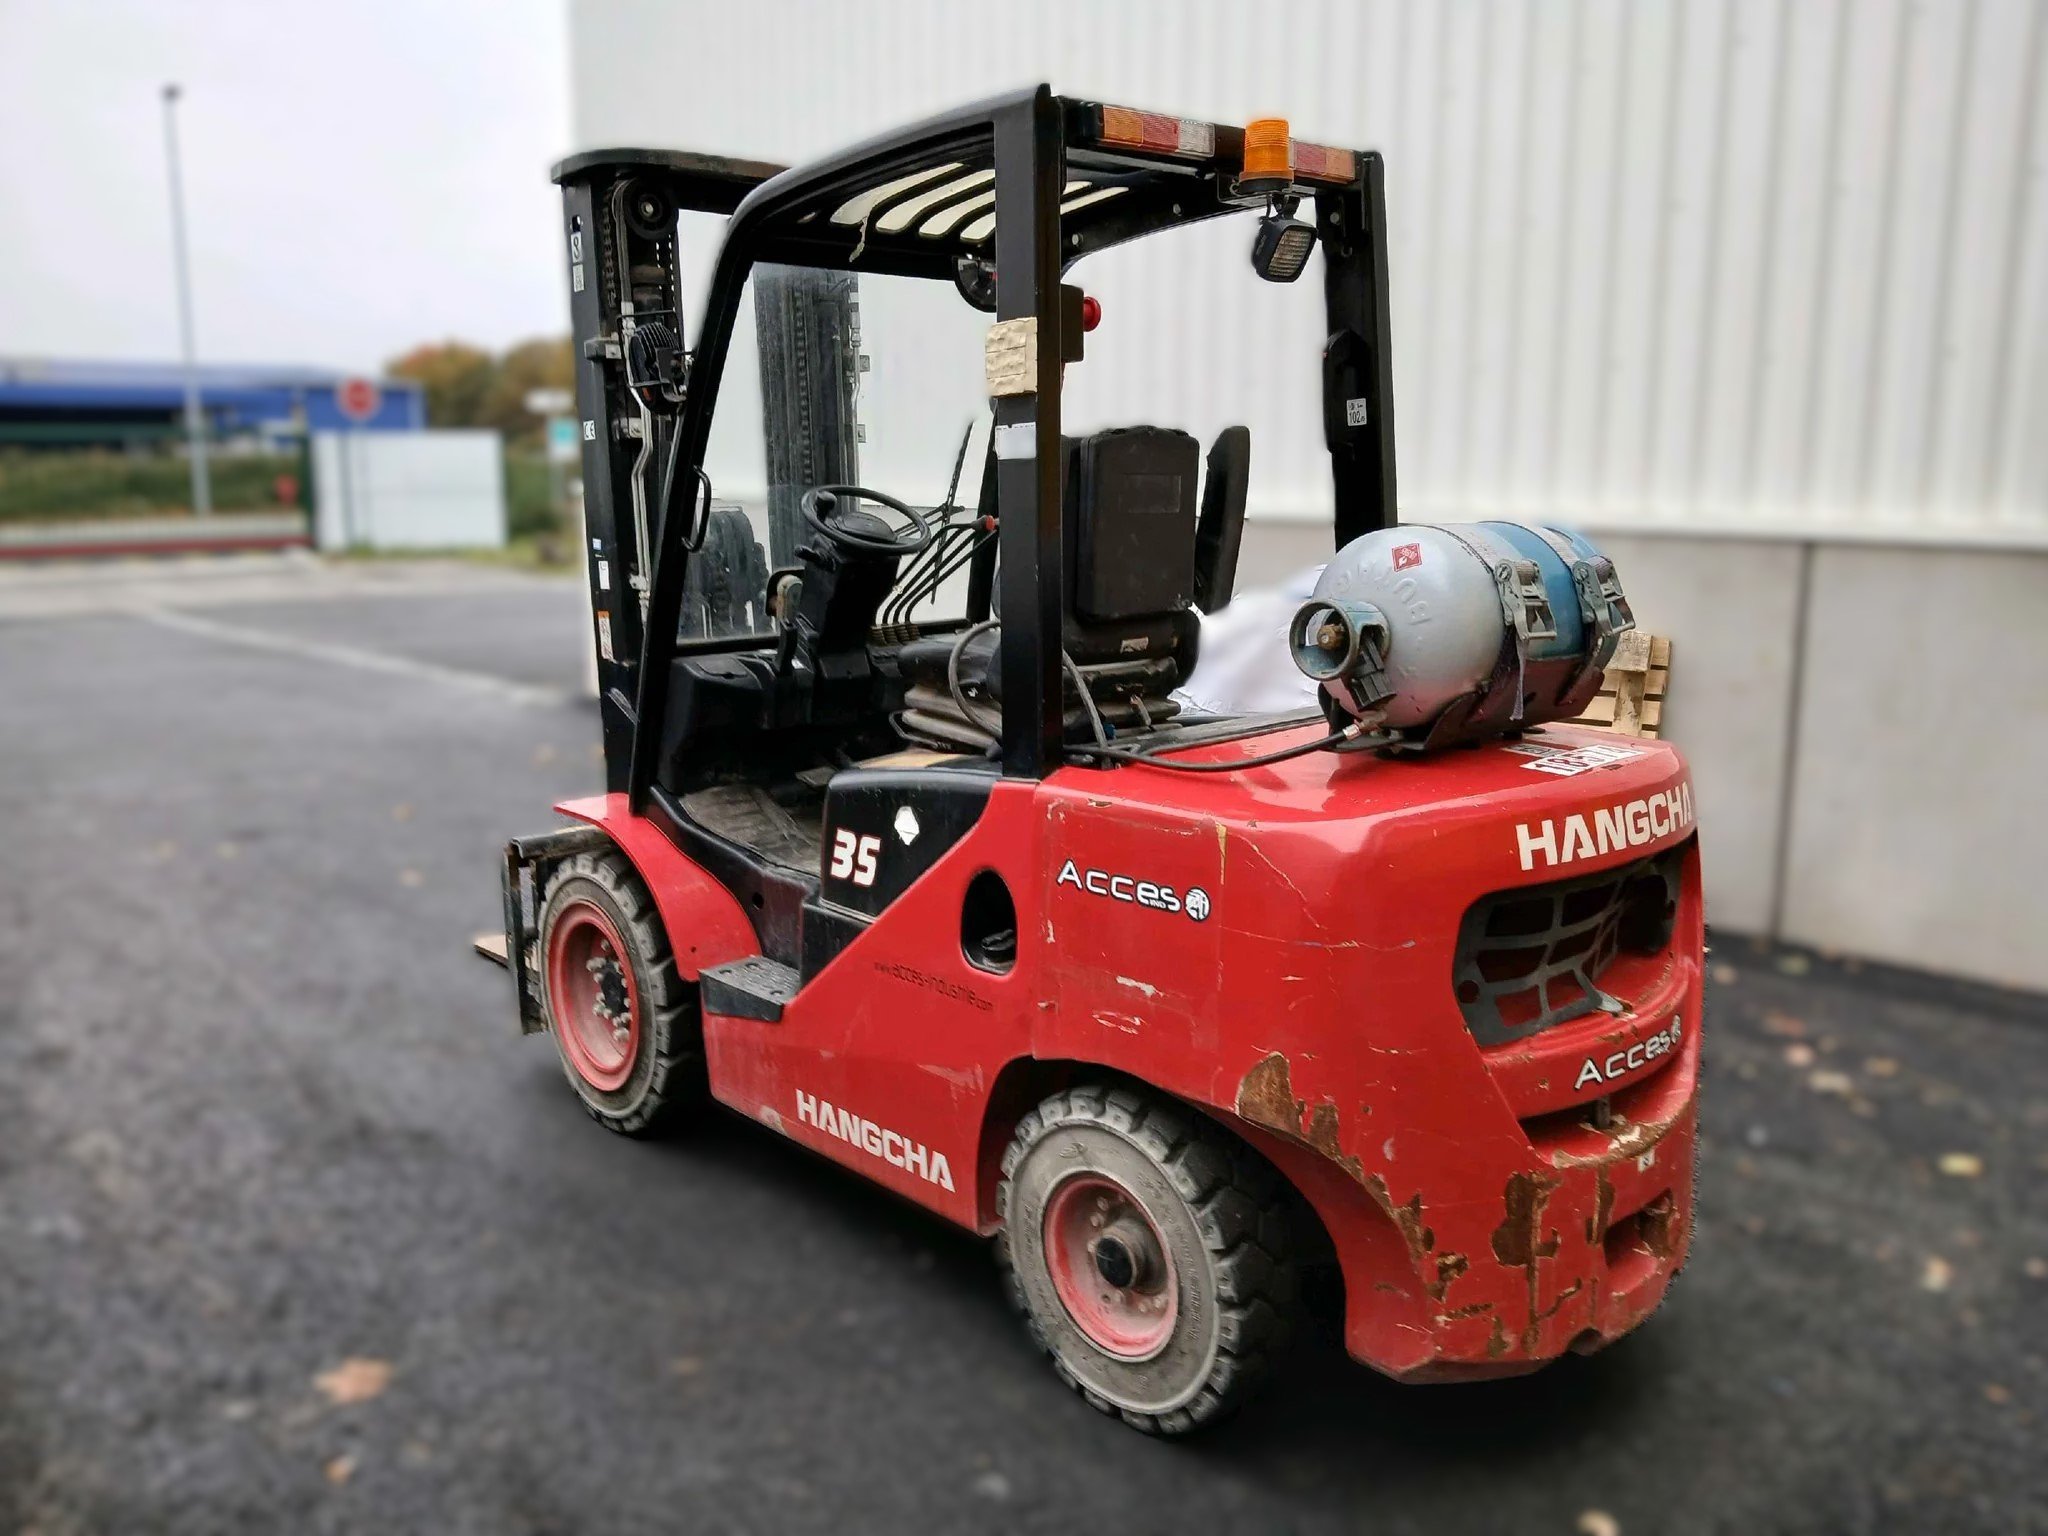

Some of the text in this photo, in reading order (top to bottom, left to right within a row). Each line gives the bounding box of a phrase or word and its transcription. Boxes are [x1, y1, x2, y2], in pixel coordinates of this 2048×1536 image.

[1515, 781, 1693, 871] HANGCHA
[831, 827, 881, 886] 35
[1056, 859, 1182, 913] Acces
[1574, 1030, 1670, 1090] Acces
[796, 1088, 956, 1193] HANGCHA
